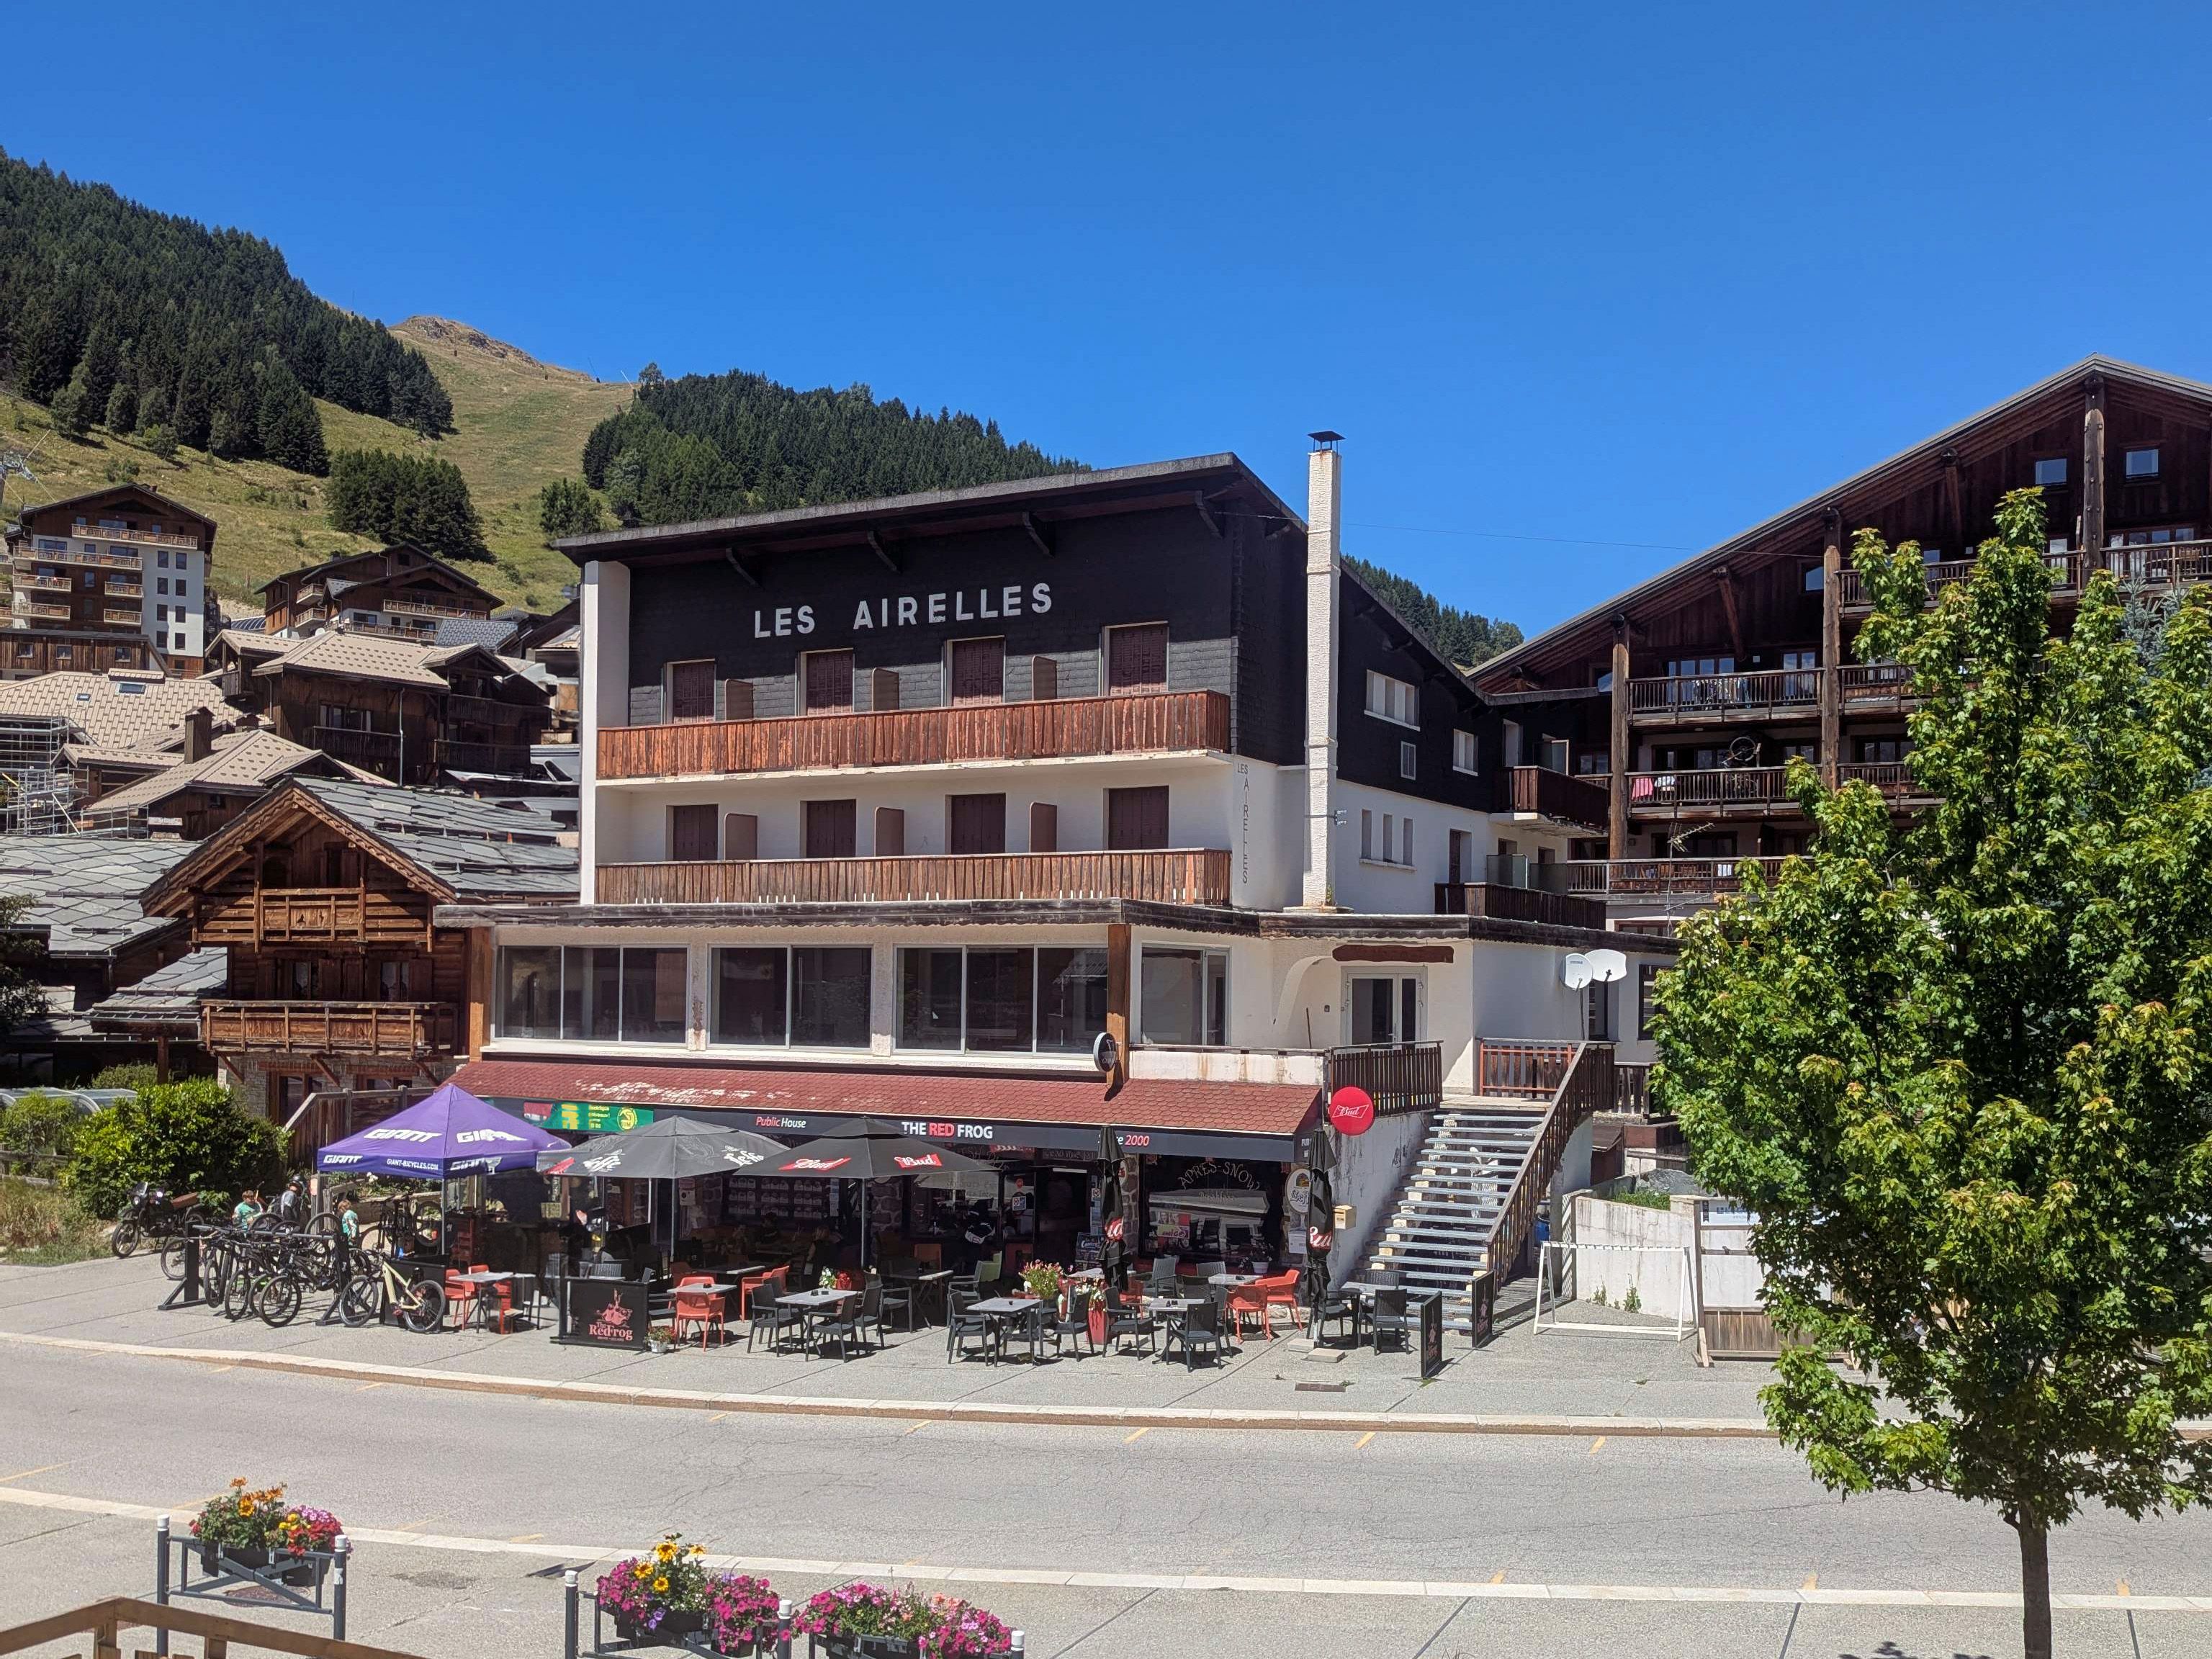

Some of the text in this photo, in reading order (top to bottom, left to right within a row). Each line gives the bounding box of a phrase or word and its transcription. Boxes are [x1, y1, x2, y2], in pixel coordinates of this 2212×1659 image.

[754, 583, 1053, 639] LES AIRELLES
[1237, 763, 1249, 774] LES
[1337, 1106, 1359, 1116] Bud
[756, 1117, 806, 1128] Public House
[364, 1129, 442, 1143] GIANT
[902, 1121, 993, 1139] THE RED FROG
[1125, 1134, 1150, 1146] 2000
[323, 1154, 363, 1164] GIANT
[894, 1154, 937, 1166] Bud
